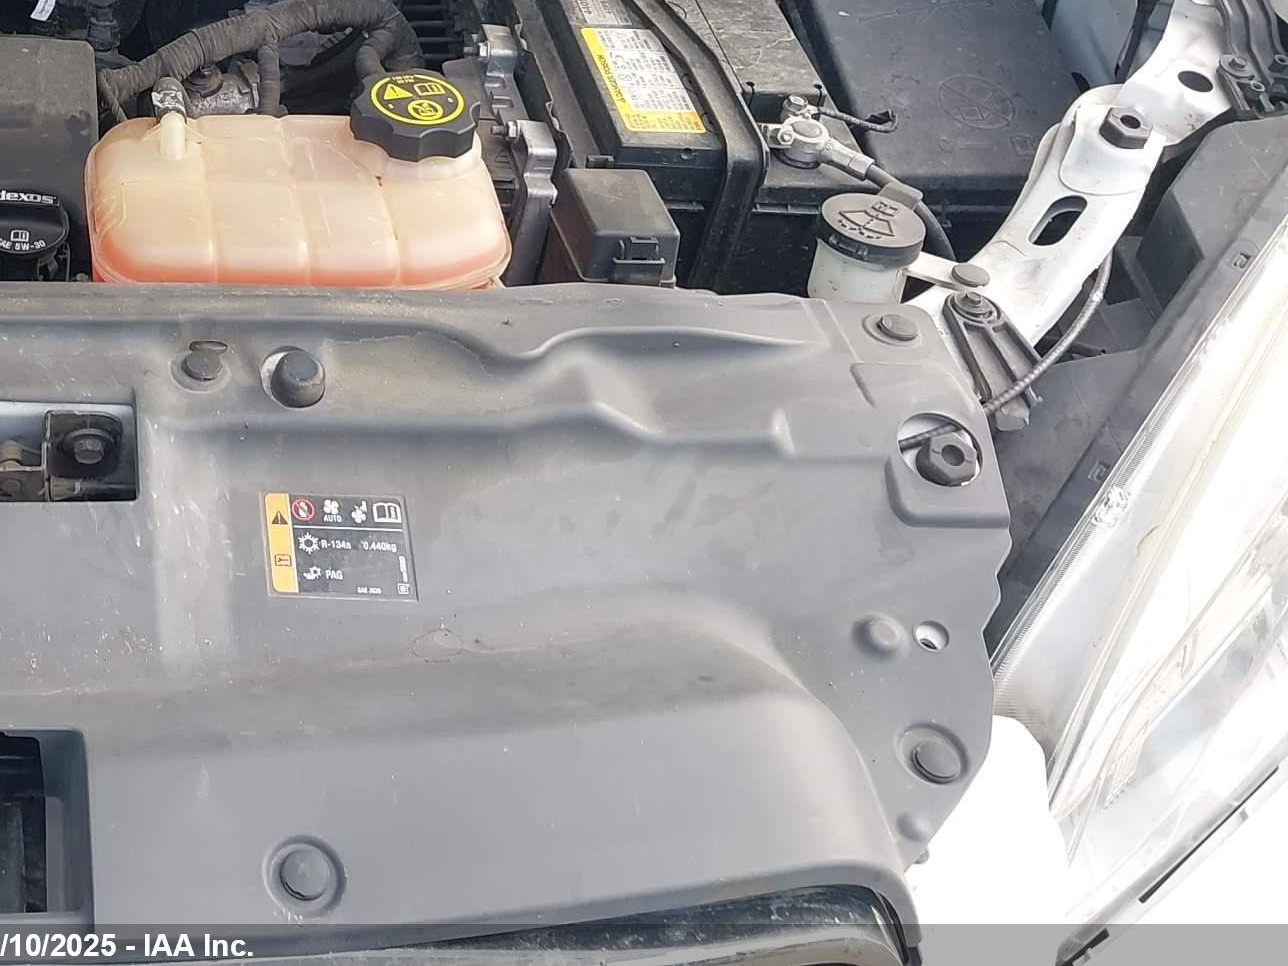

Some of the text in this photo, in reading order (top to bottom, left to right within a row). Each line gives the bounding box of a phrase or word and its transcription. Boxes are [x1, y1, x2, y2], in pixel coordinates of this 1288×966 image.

[14, 239, 46, 251] 5W-30
[323, 514, 343, 523] AUTO
[320, 539, 352, 550] R-134a
[325, 569, 344, 580] PAG
